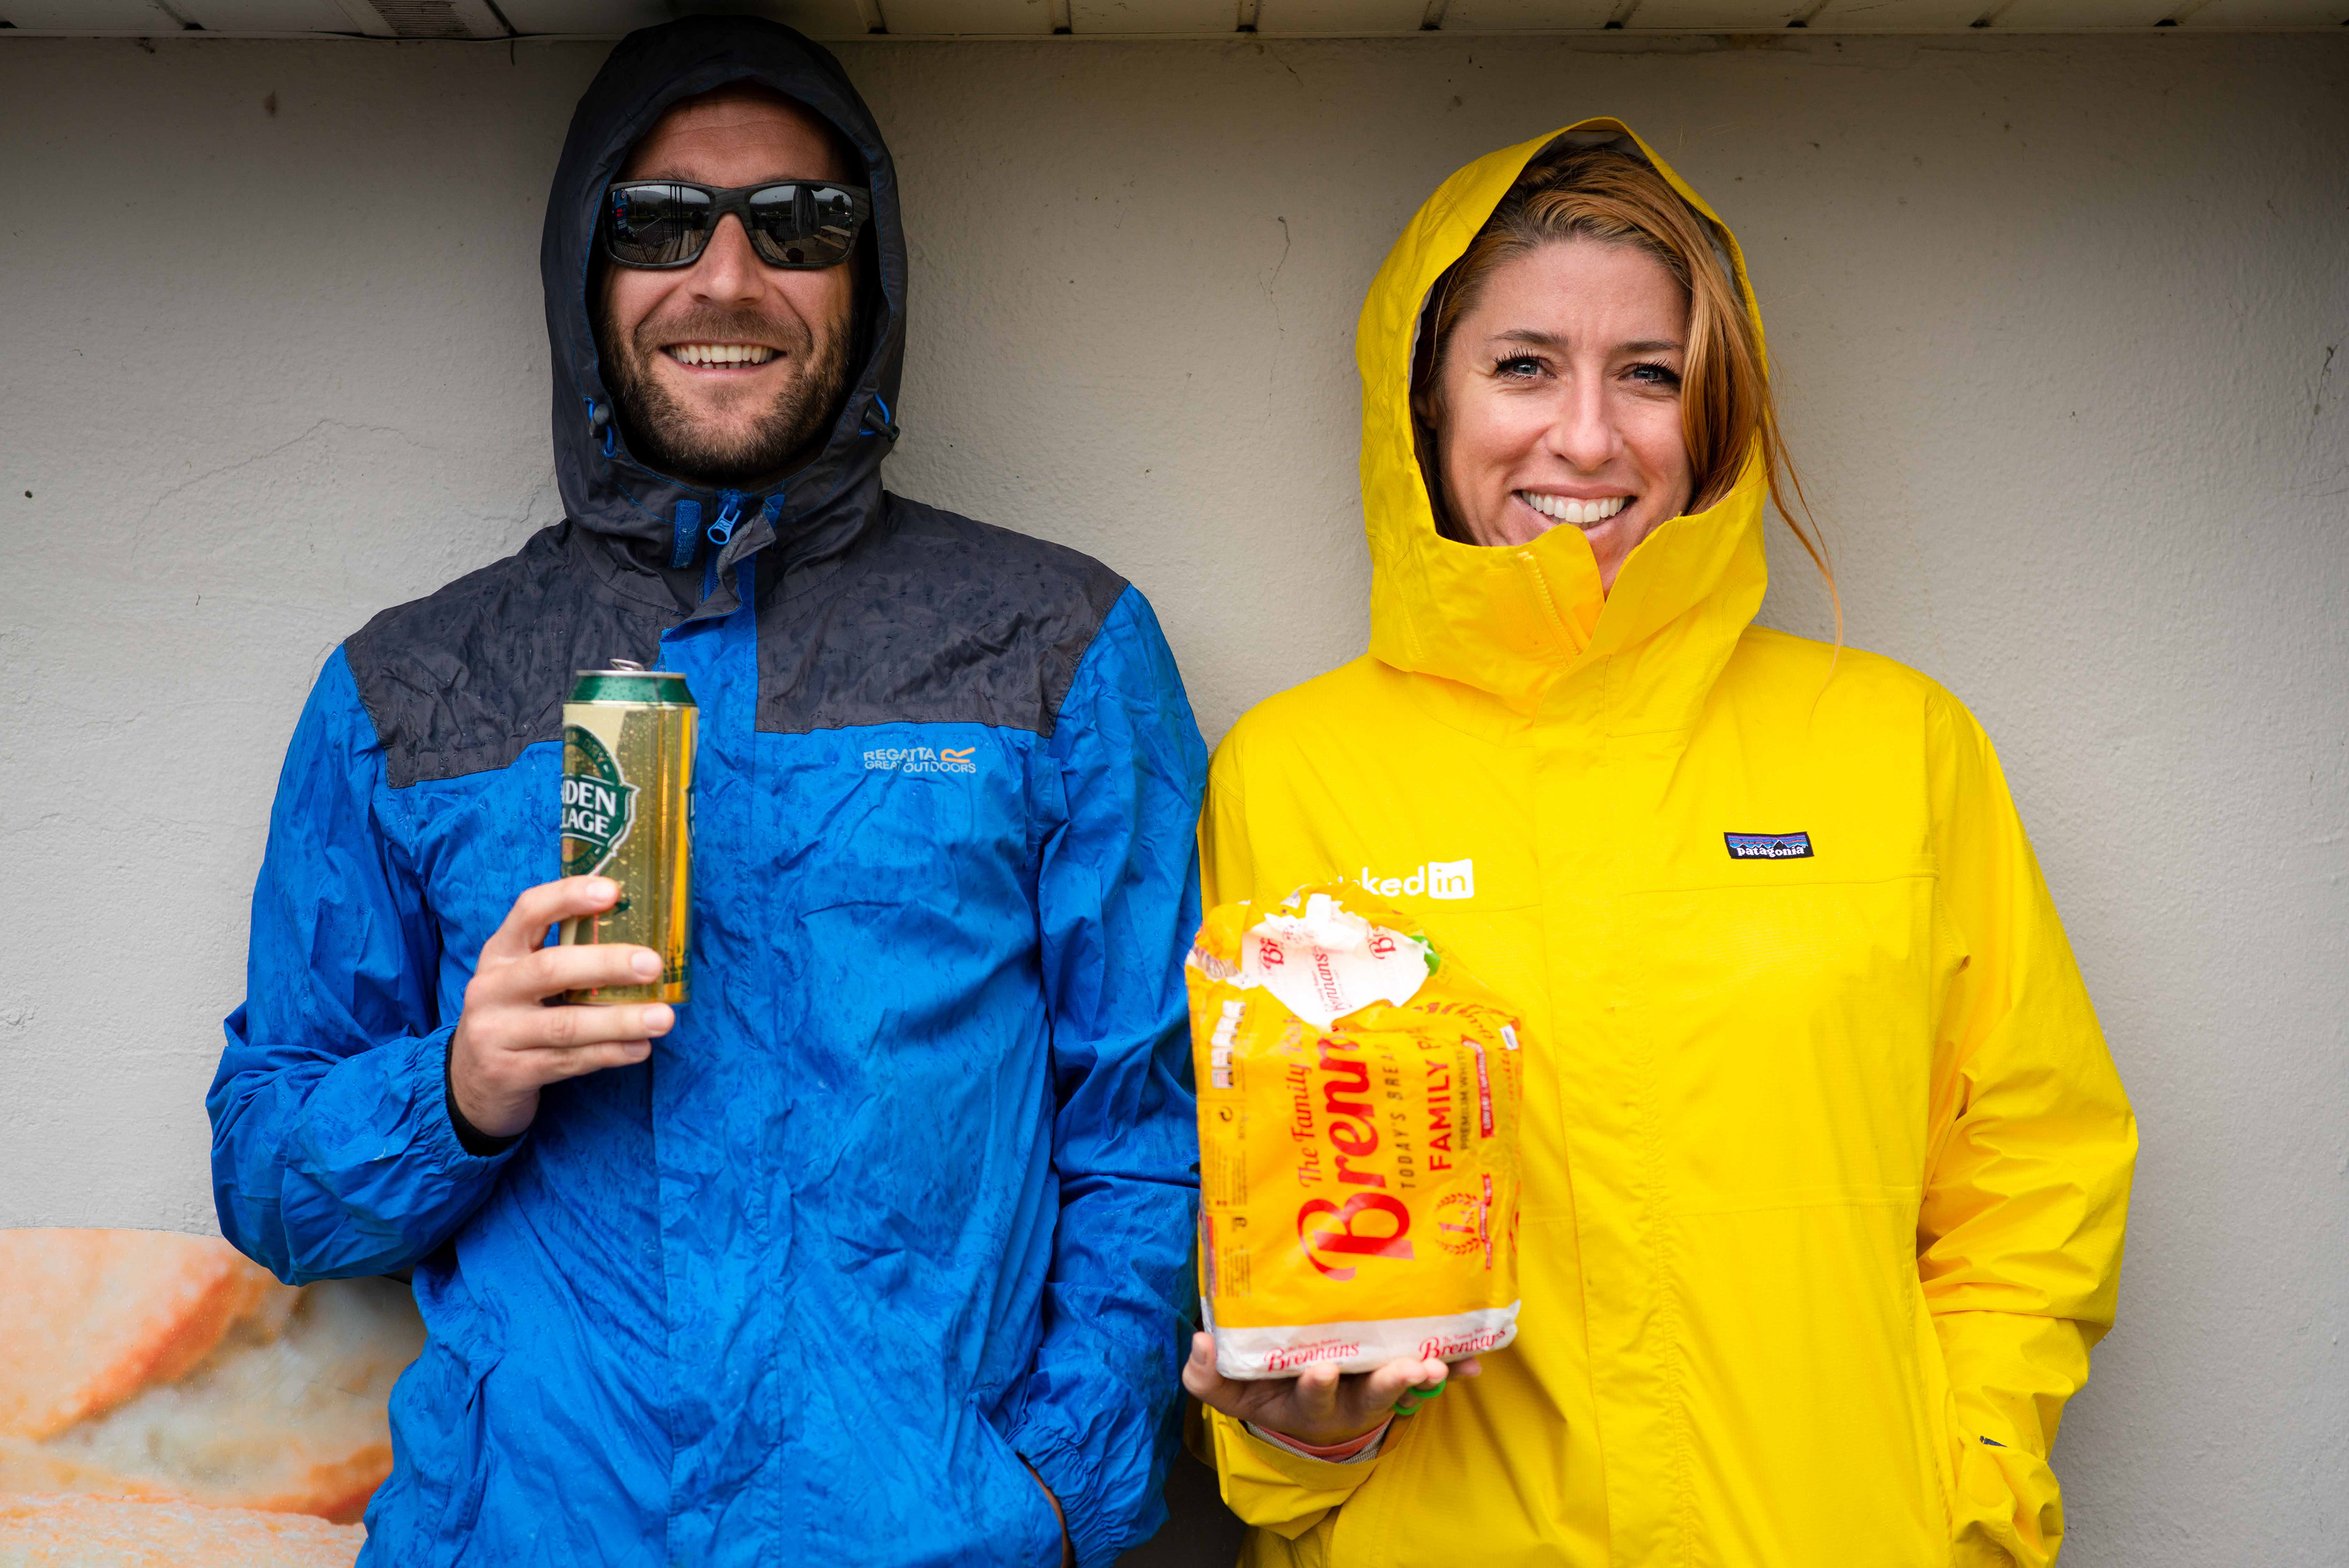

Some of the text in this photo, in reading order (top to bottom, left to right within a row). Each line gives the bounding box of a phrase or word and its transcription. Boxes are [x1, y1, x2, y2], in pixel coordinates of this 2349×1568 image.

[863, 747, 937, 762] REGATTA
[864, 760, 976, 773] GREAT OUTDOORS
[562, 779, 617, 817] DEN
[1737, 846, 1805, 858] patagonia
[1286, 1063, 1316, 1142] Family
[1425, 1060, 1452, 1172] FAMILY
[1298, 1147, 1323, 1187] The
[1390, 1112, 1416, 1189] TODAY'S
[1264, 1341, 1360, 1372] Brennans
